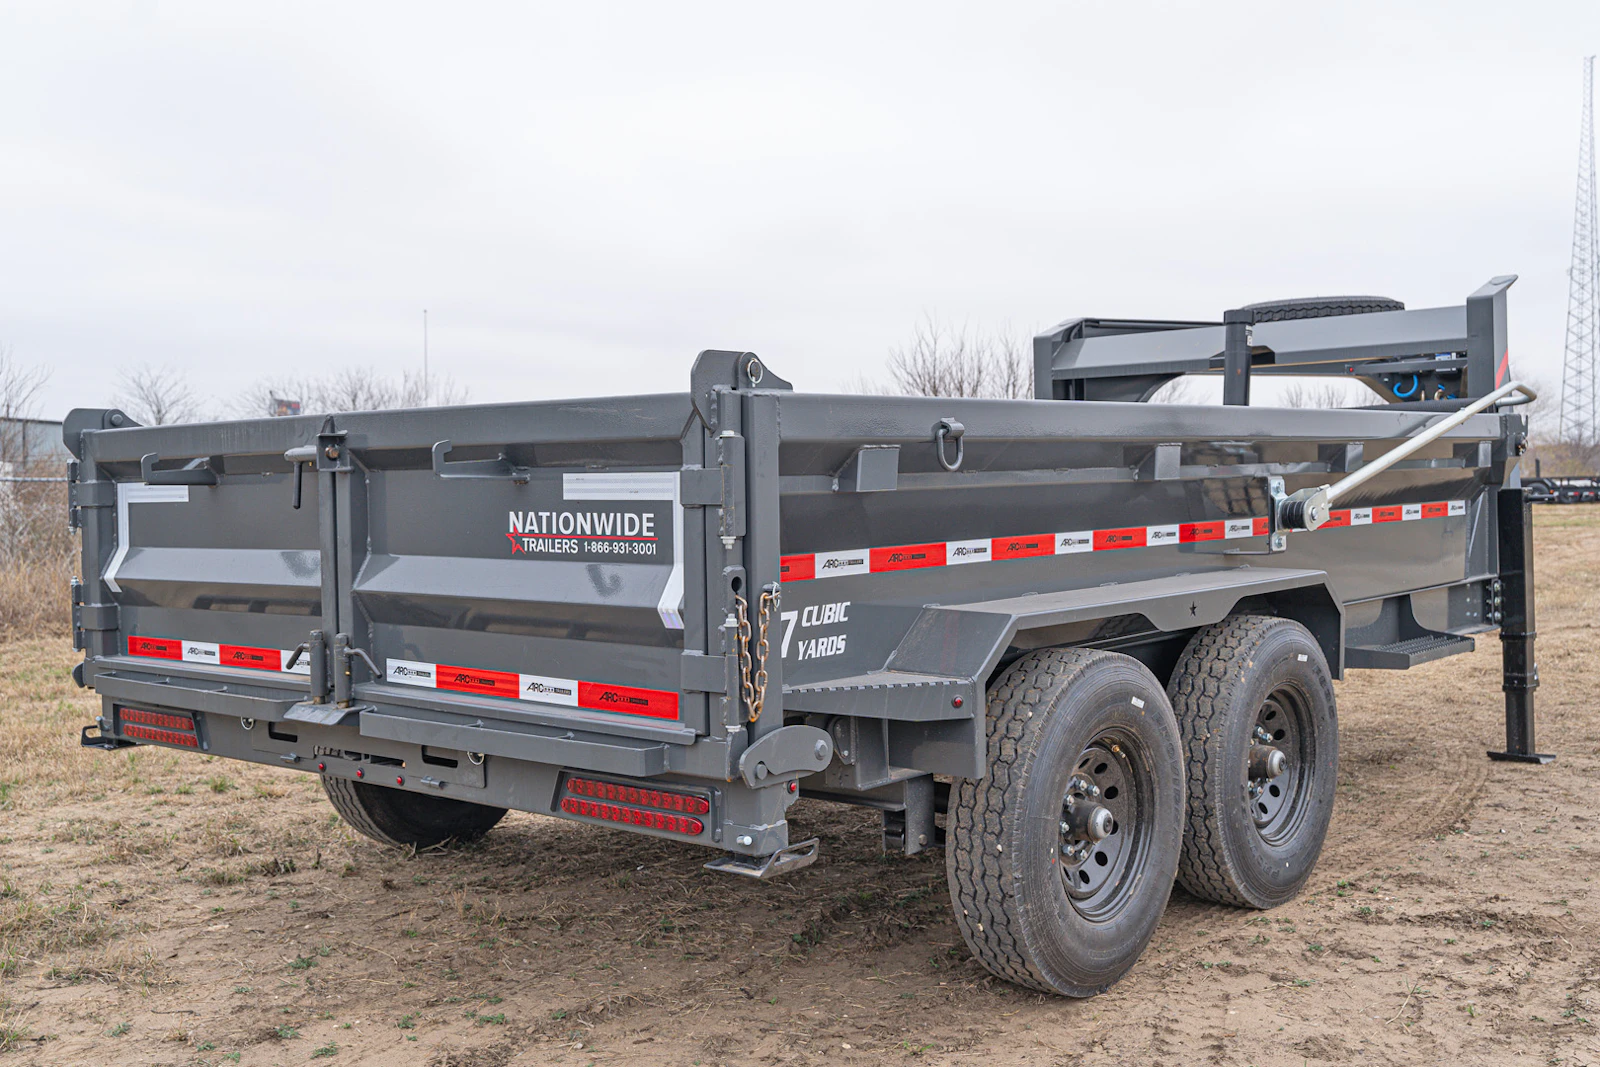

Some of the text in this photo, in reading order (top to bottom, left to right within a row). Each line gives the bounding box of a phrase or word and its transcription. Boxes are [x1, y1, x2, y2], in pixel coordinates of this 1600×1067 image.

[508, 511, 655, 537] NATIONWIDE
[522, 538, 657, 555] TRAILERS 1-866-931-3001
[888, 552, 904, 563] ARC
[822, 558, 838, 570] ARC
[802, 602, 851, 627] CUBIC
[798, 634, 847, 660] YARDS
[393, 665, 408, 676] ARC
[454, 673, 470, 684] ARC
[526, 682, 544, 693] ARC
[598, 691, 618, 703] ARC
